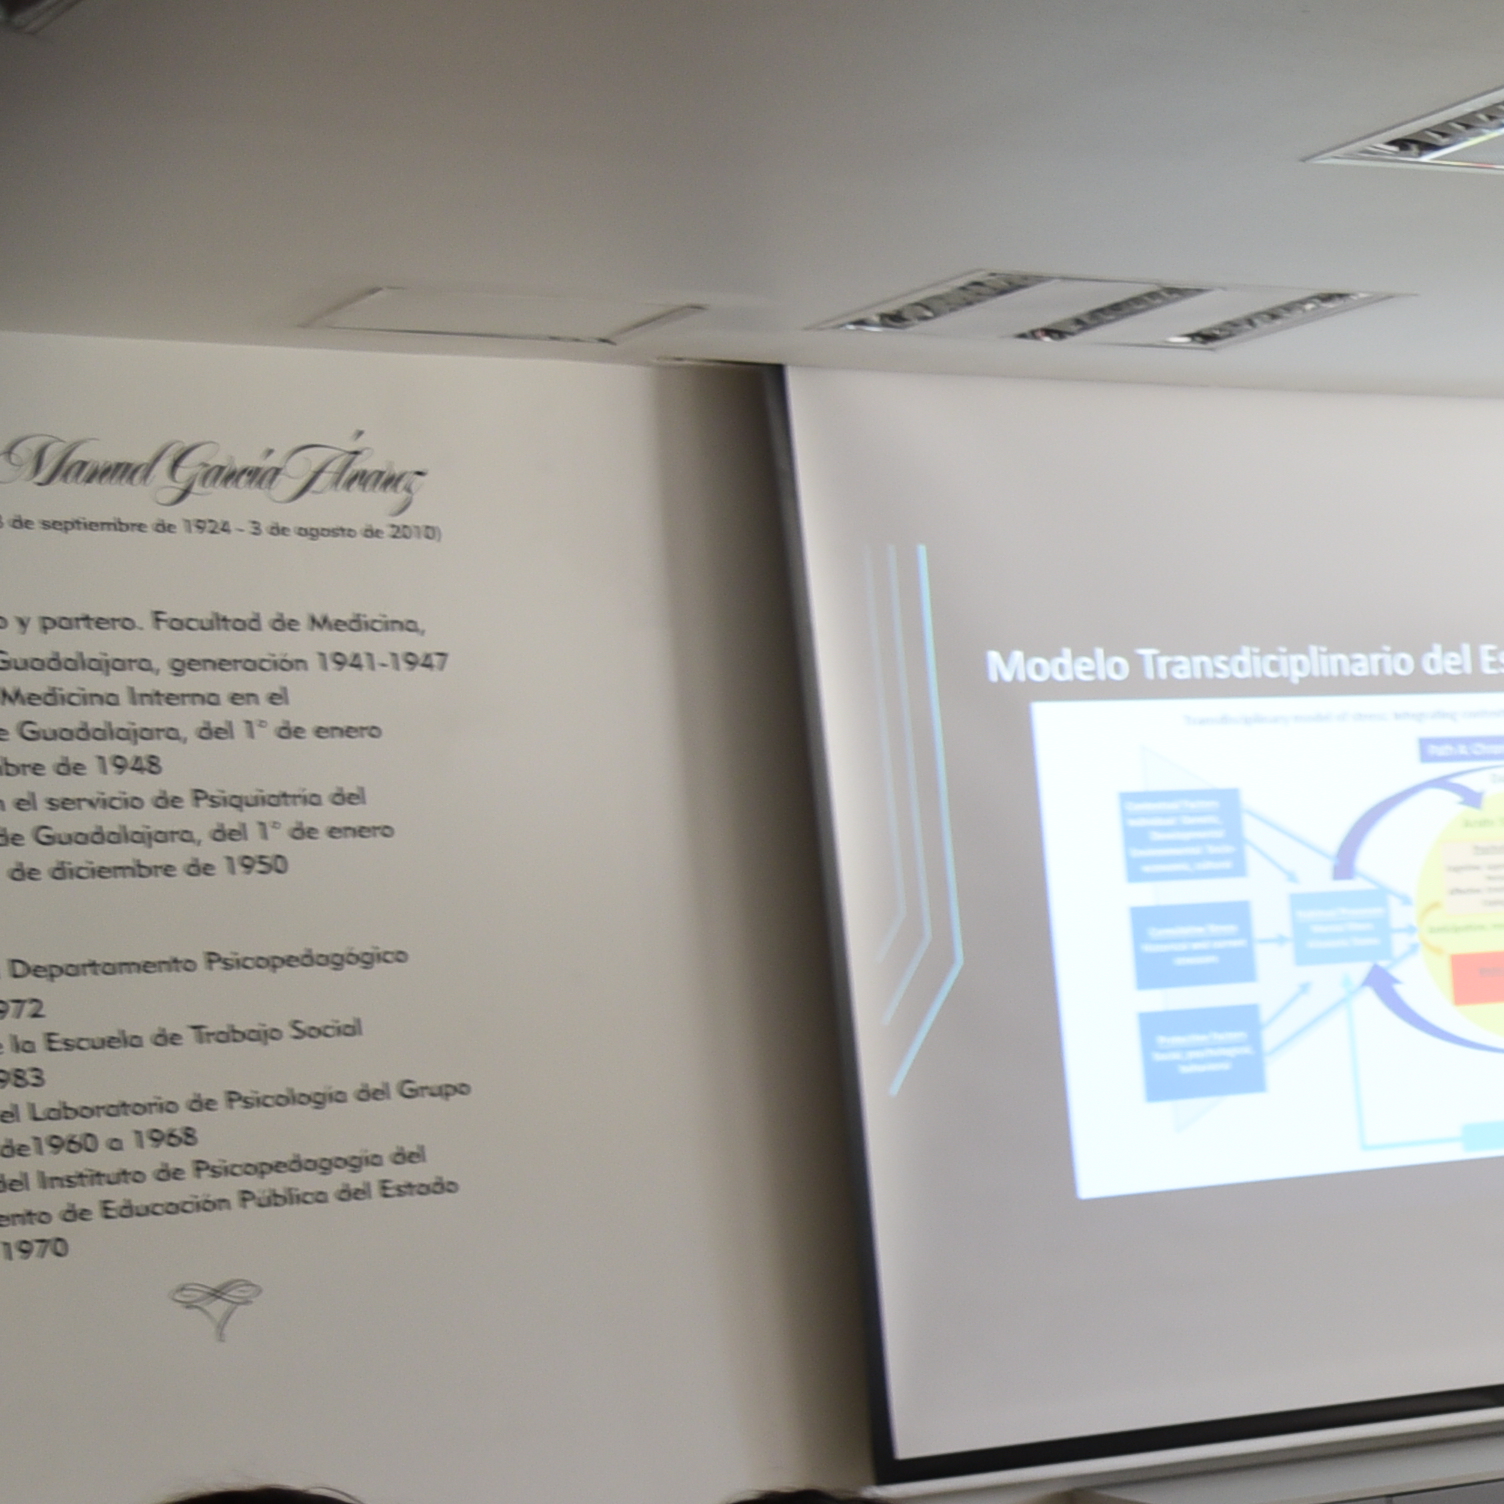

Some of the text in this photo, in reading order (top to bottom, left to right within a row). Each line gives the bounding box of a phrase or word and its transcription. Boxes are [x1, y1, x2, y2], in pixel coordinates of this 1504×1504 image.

[154, 441, 284, 507] García
[268, 429, 428, 517] Álvarez
[7, 515, 35, 530] de
[38, 517, 148, 534] septiembre
[151, 519, 177, 534] de
[183, 519, 231, 534] 1924
[249, 521, 263, 536] 3
[266, 522, 291, 537] de
[294, 526, 357, 541] agosto
[360, 524, 384, 539] de
[387, 524, 442, 542] 2010)
[14, 612, 425, 636] y partero. Facultad de Medicina,
[168, 653, 308, 677] generación
[317, 652, 449, 671] 1941-1947
[987, 649, 1131, 684] Modelo
[1136, 646, 1416, 686] Transdiciplinario
[1421, 643, 1473, 676] del
[0, 686, 289, 706] Medicina Interna en el
[16, 721, 187, 746] Guadalajara,
[195, 721, 235, 740] del
[274, 720, 306, 739] de
[312, 725, 382, 739] enero
[53, 756, 87, 776] de
[96, 756, 162, 775] 1948
[12, 787, 366, 812] el servicio de Psiquiatría del
[31, 824, 201, 849] Guadalajara,
[209, 822, 248, 842] del
[288, 821, 319, 840] de
[325, 825, 395, 839] enero
[7, 856, 288, 882] de diciembre de 1950
[7, 946, 409, 983] Departamento Psicopedagógico
[9, 1017, 363, 1054] la Escuela de Trabajo Social
[27, 1096, 180, 1122] Laboratorio
[185, 1093, 218, 1112] de
[224, 1086, 348, 1110] Psicología
[353, 1082, 391, 1102] del
[396, 1079, 471, 1101] Grupo
[105, 1138, 124, 1151] a
[133, 1126, 198, 1149] 1968
[37, 1168, 147, 1190] Instituto
[152, 1162, 186, 1182] de
[191, 1149, 384, 1179] Psicopedagogía
[389, 1144, 426, 1165] del
[58, 1202, 93, 1223] de
[99, 1194, 232, 1220] Educación
[237, 1187, 329, 1209] Pública
[333, 1181, 372, 1202] del
[378, 1176, 459, 1198] Estado
